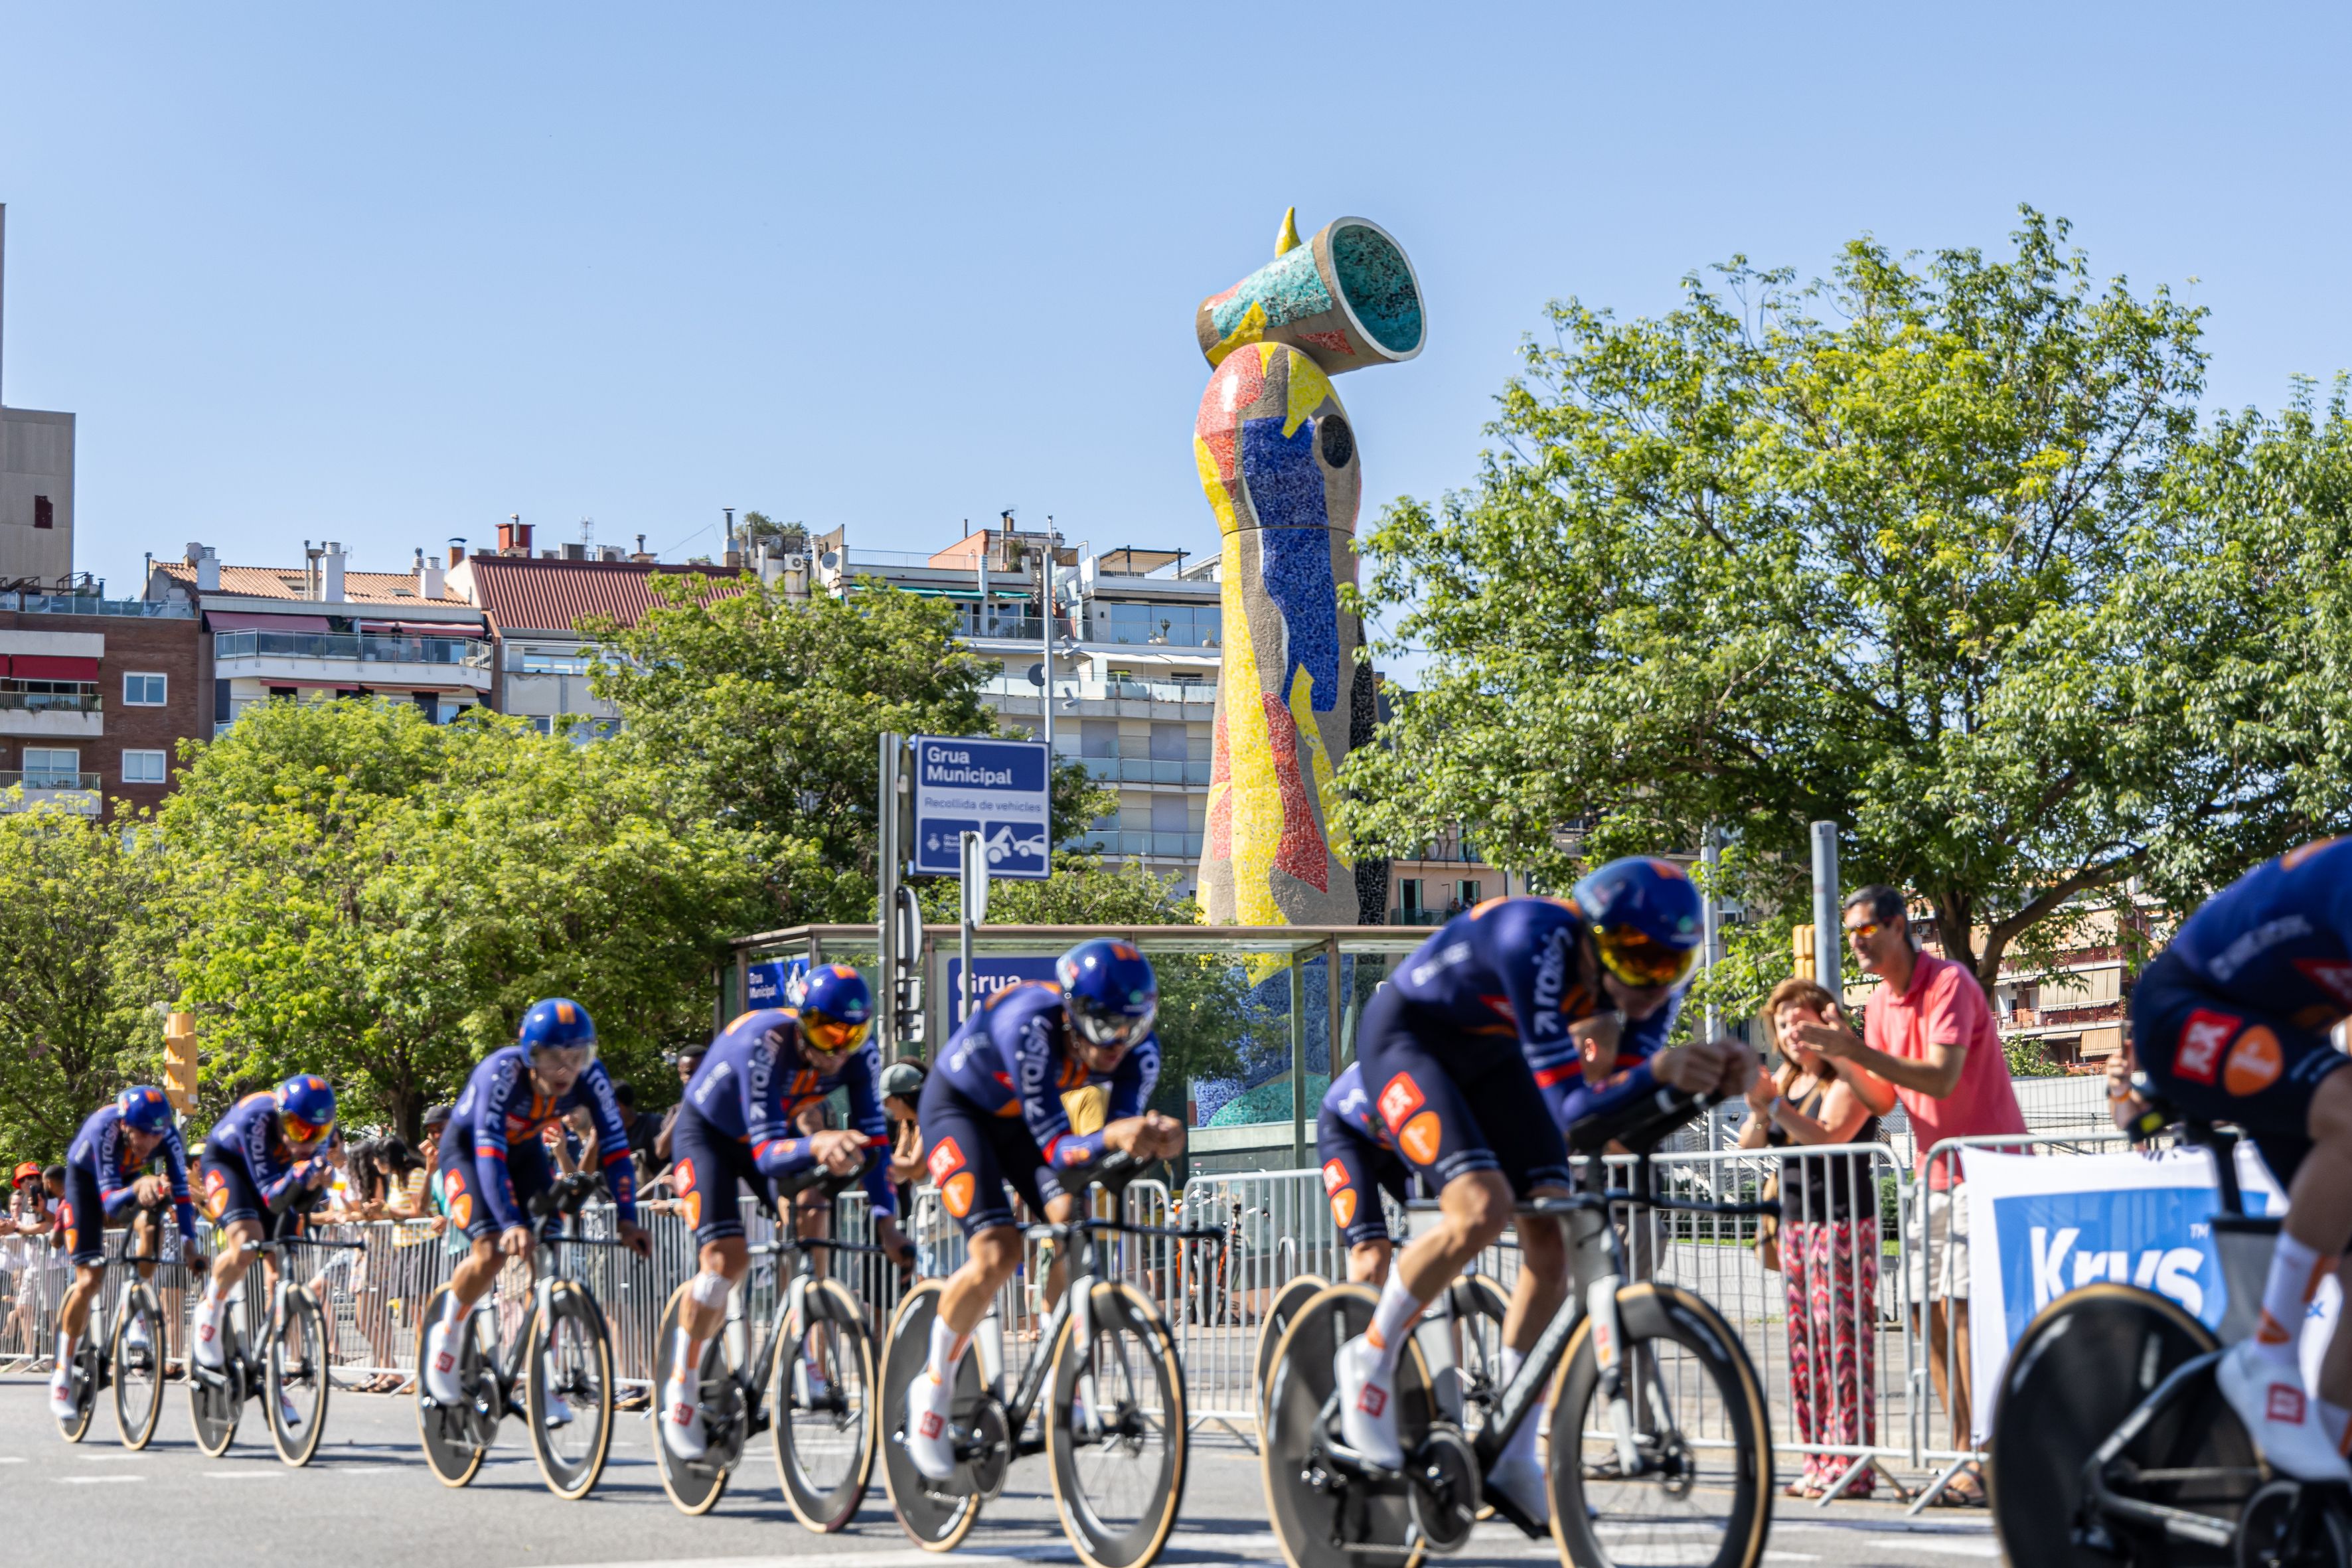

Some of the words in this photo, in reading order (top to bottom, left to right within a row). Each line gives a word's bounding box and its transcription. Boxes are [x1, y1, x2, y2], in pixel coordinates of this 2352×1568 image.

[927, 745, 970, 764] Grua
[927, 765, 1012, 786] Municipal
[925, 797, 977, 810] Recollida
[979, 800, 994, 811] de
[996, 801, 1042, 813] vehicles
